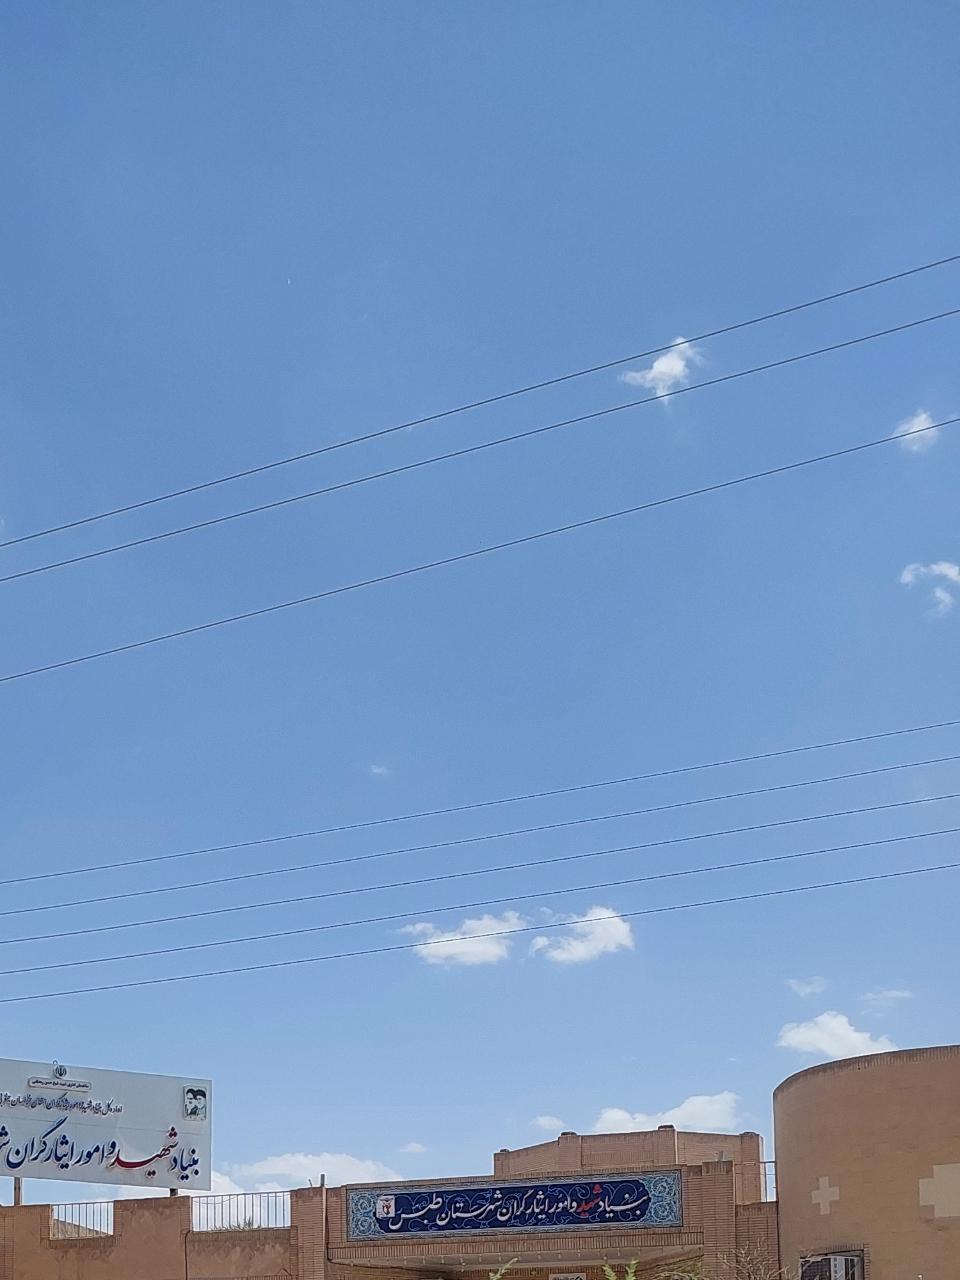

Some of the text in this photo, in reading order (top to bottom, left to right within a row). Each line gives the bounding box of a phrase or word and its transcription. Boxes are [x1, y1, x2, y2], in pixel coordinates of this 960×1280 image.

[6, 1116, 74, 1170] ایثارگران
[73, 1144, 105, 1166] امور
[106, 1140, 117, 1157] و
[108, 1126, 179, 1177] شهید
[170, 1148, 200, 1181] بنیاد
[388, 1184, 650, 1230] بنیاد شهید و امور ایثارگران شهرستان طبس
